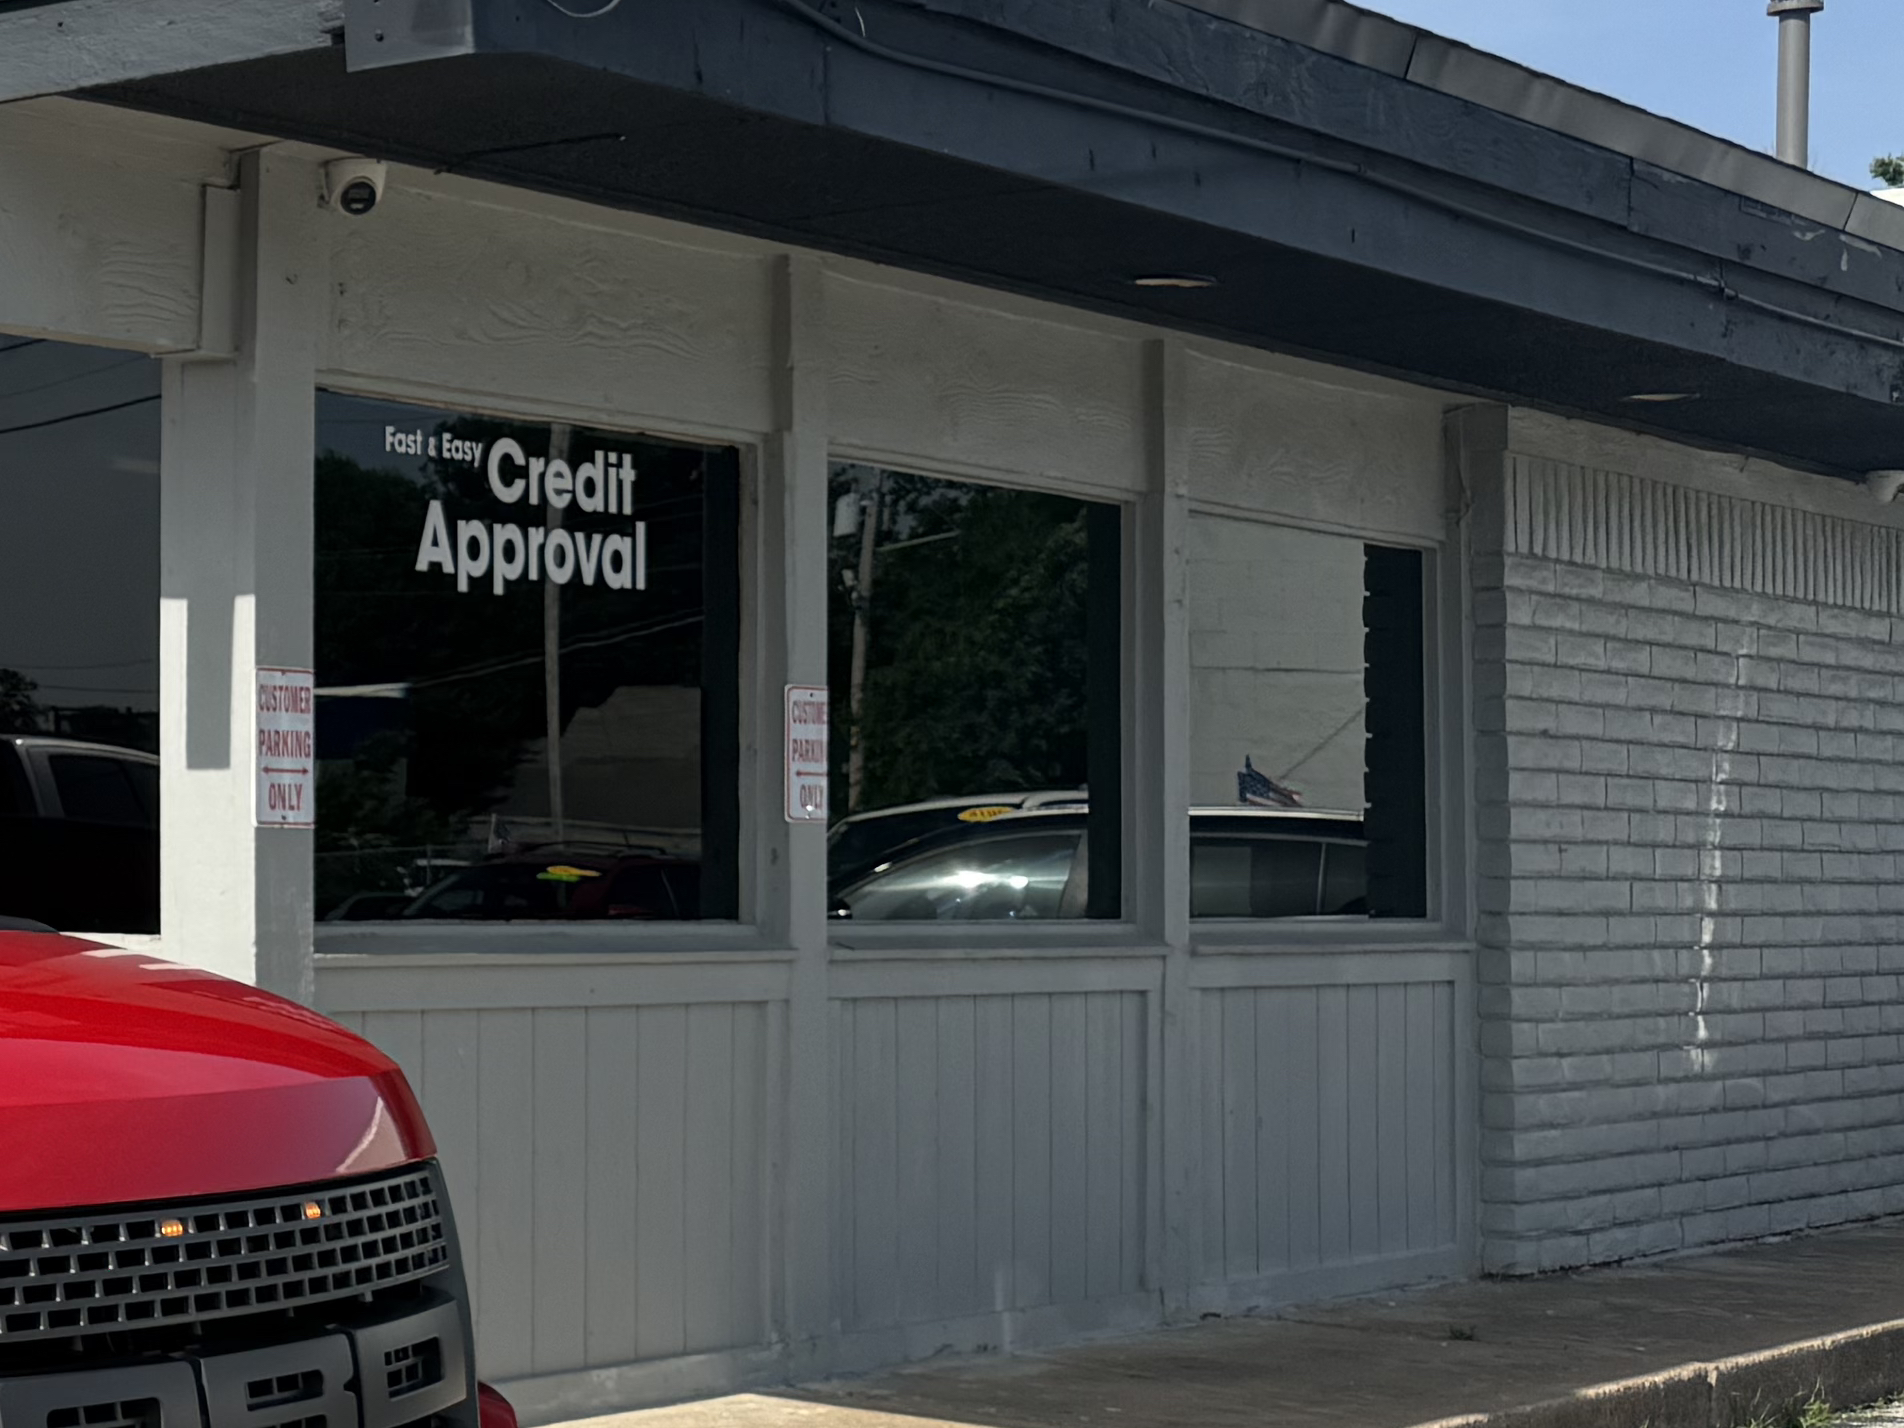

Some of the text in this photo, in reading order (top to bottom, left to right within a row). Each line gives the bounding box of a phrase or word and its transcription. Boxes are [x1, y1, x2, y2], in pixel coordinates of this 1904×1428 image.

[385, 426, 637, 515] Fast & Easy Credit
[415, 500, 646, 596] Approval
[259, 684, 311, 714] CUSTOMER
[259, 730, 311, 758] PARKING
[268, 783, 302, 811] ONLY
